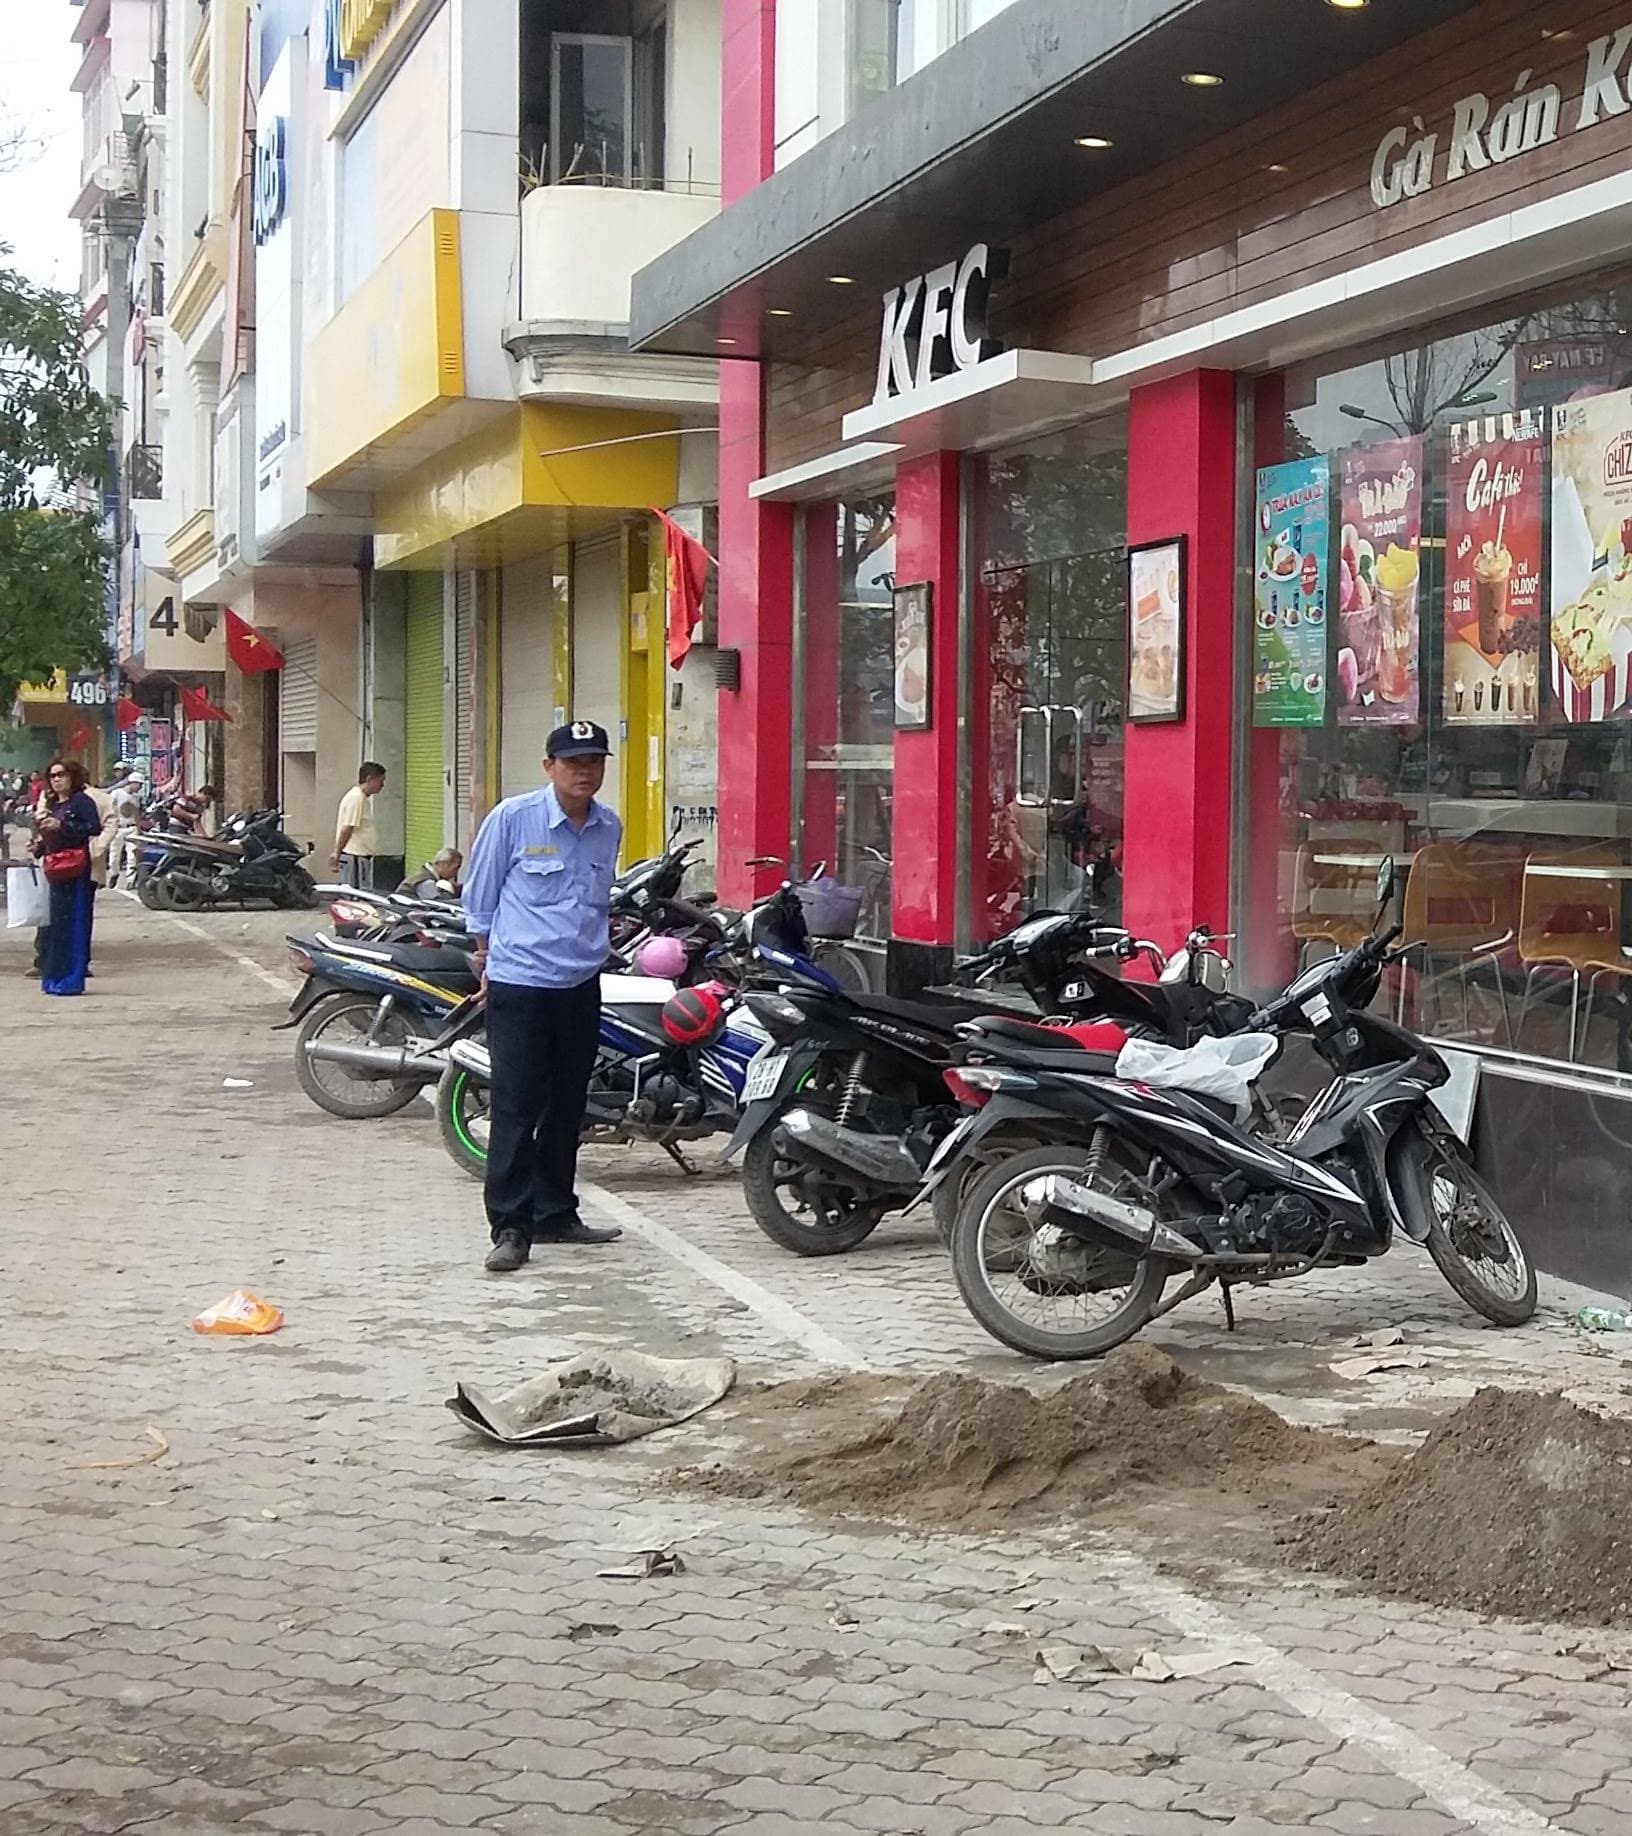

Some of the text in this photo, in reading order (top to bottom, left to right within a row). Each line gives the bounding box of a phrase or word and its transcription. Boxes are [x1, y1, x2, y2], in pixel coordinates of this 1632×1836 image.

[1370, 115, 1438, 208] Gà
[1446, 68, 1561, 181] Rán
[873, 243, 988, 404] KFC
[149, 597, 179, 637] 4
[70, 680, 107, 704] 496
